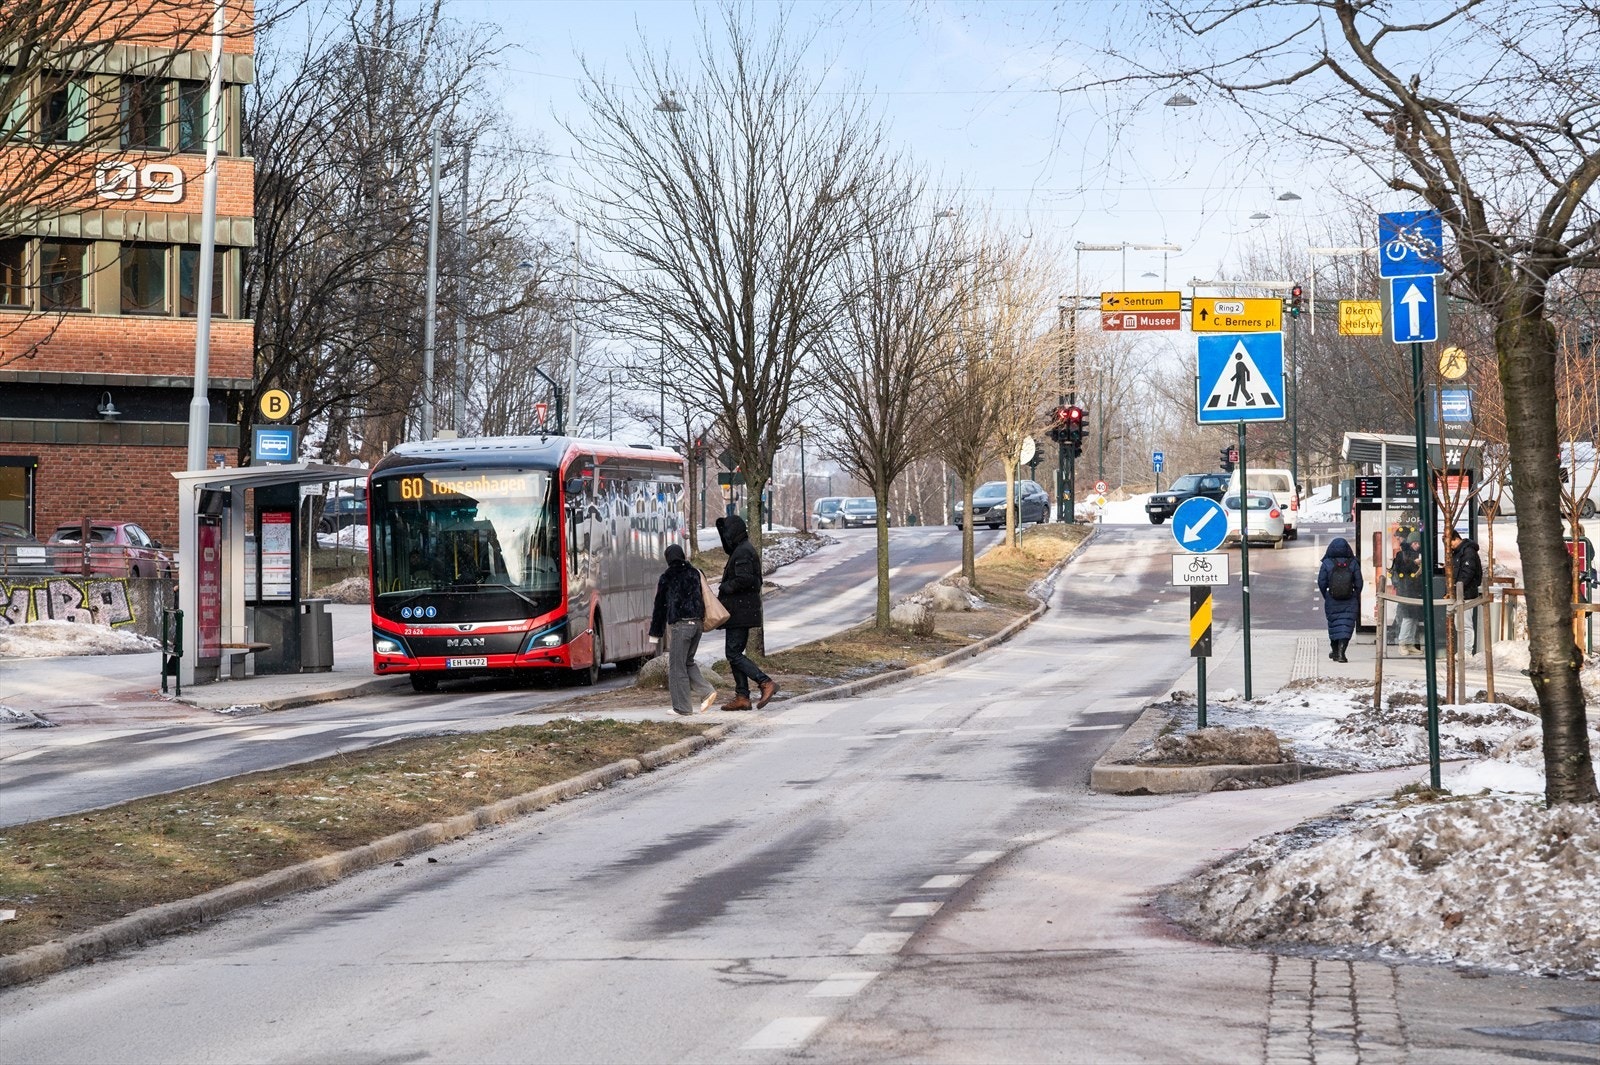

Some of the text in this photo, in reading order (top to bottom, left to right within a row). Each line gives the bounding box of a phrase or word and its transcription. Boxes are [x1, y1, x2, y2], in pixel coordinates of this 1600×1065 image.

[1124, 297, 1163, 306] Sentrum
[1218, 304, 1241, 313] Ring 2
[1345, 306, 1373, 315] Økern
[1140, 316, 1176, 326] Museer
[1213, 317, 1278, 329] C. Berners pl.
[1447, 353, 1460, 370] A
[270, 397, 281, 412] B
[1444, 423, 1462, 431] Tøyen
[401, 475, 526, 499] 60 Tonsenhagen
[1097, 483, 1106, 491] 40
[1183, 574, 1218, 583] Unntatt
[446, 638, 485, 648] MAN
[463, 658, 486, 667] 14472
